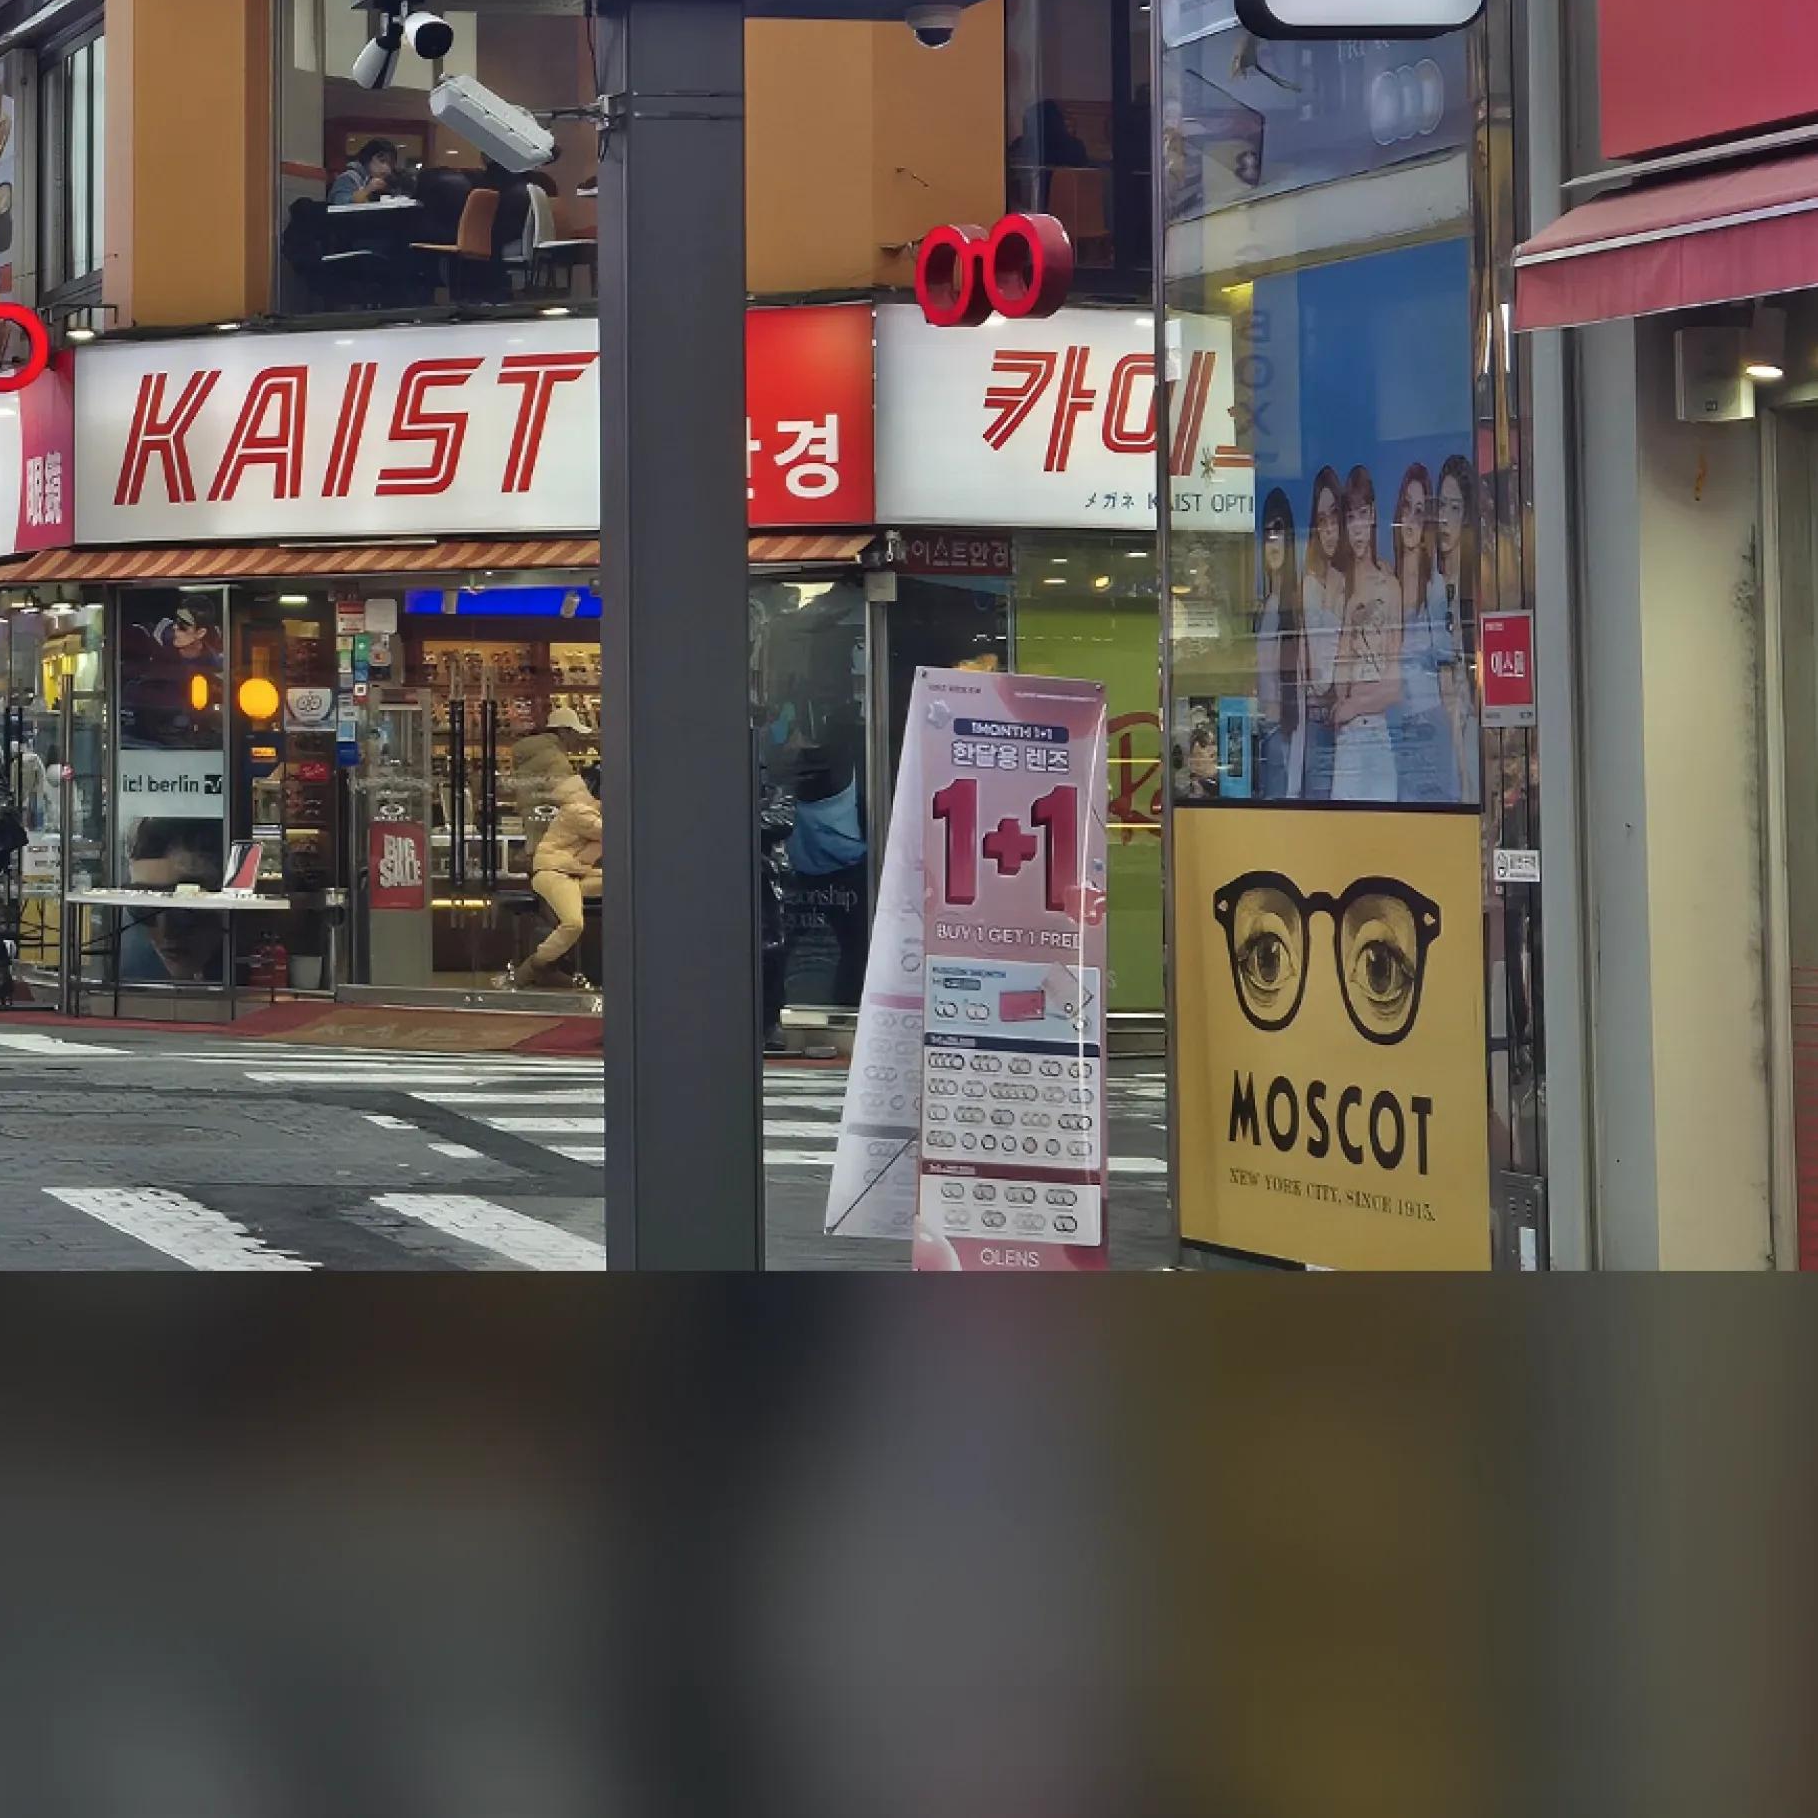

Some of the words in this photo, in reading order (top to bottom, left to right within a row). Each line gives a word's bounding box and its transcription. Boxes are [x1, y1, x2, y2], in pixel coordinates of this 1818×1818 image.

[113, 352, 600, 506] KAIST
[1085, 493, 1134, 510] メガネ
[952, 740, 1018, 770] 한달용
[1026, 746, 1069, 774] 렌즈
[148, 775, 199, 792] berlin
[384, 834, 416, 859] BIG
[932, 778, 1077, 912] 1+1
[380, 858, 422, 888] SALE
[936, 922, 971, 940] BUY
[988, 929, 1023, 943] GET
[1229, 1070, 1432, 1175] MOSCOT
[1230, 1167, 1260, 1185] NEW
[1265, 1174, 1301, 1196] YORK
[1347, 1190, 1391, 1214] SINCE
[981, 1247, 1040, 1268] OLENS
